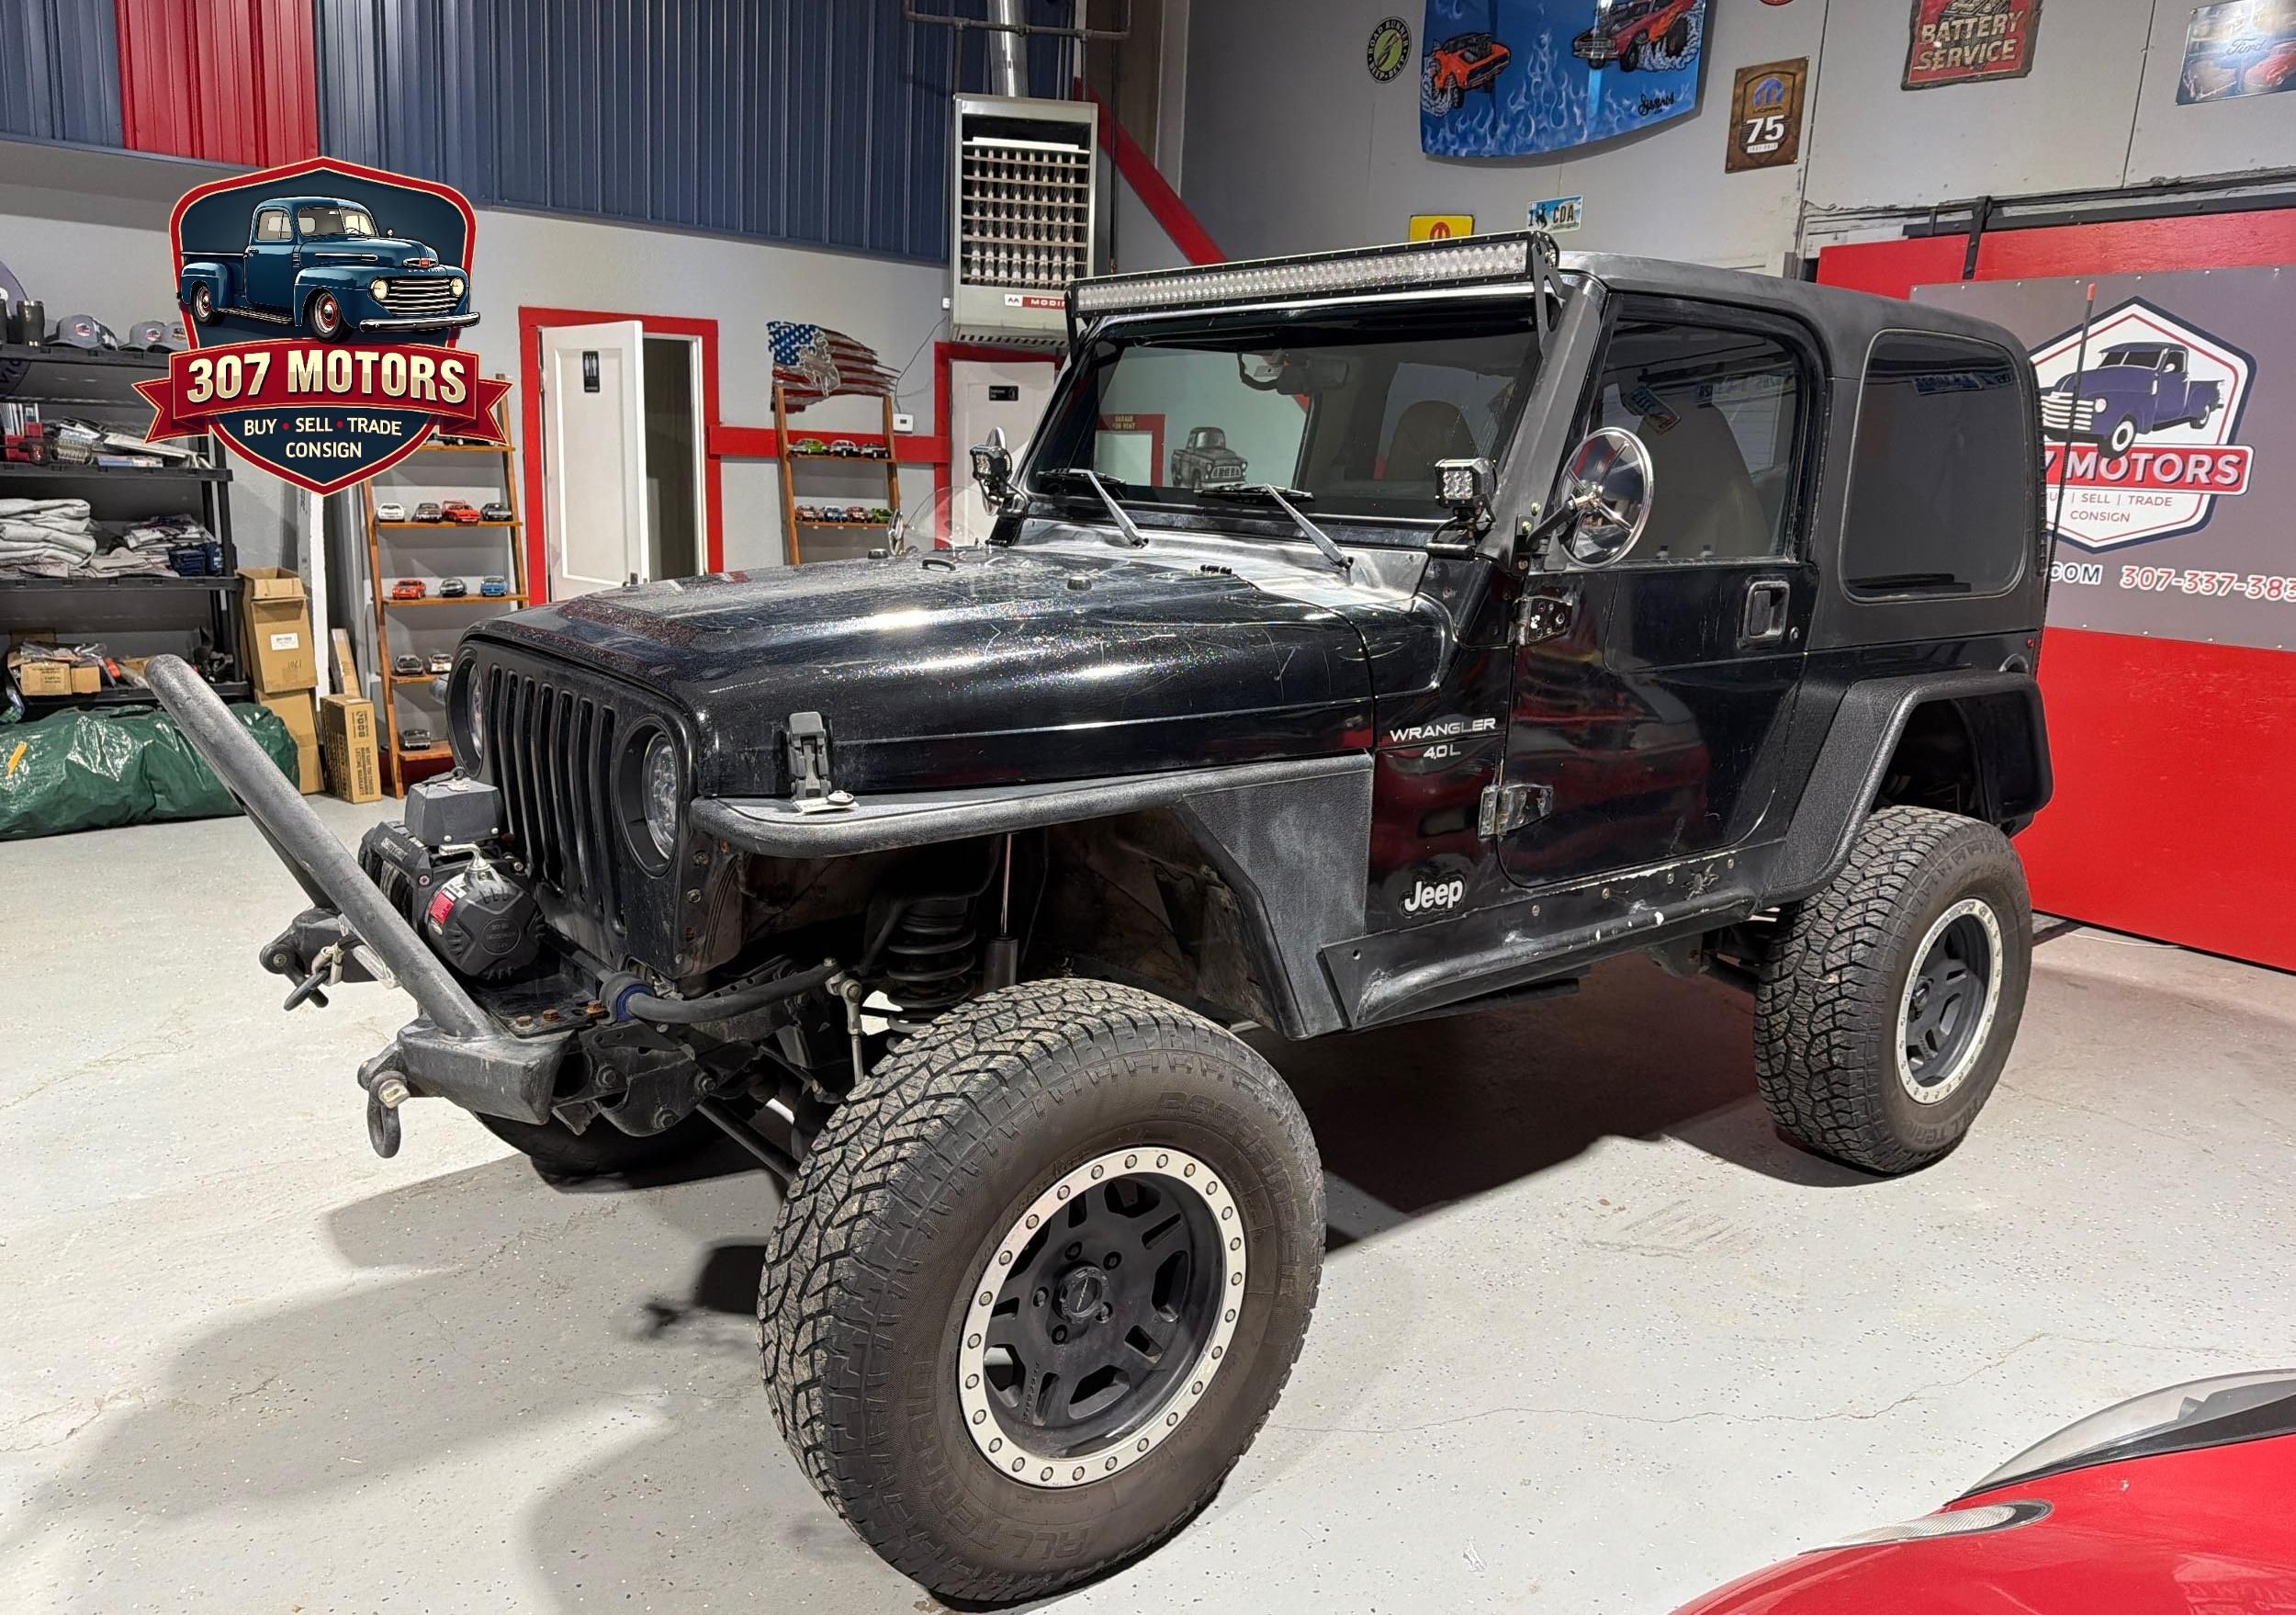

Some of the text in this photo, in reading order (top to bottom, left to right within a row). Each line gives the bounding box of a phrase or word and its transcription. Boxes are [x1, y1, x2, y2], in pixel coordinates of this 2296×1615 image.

[1367, 20, 1409, 54] ROAD RUNNER
[1921, 10, 2023, 44] BATTERY
[1913, 39, 2017, 70] SERVICE
[2226, 38, 2267, 55] Ford
[1746, 114, 1784, 143] 75
[1552, 204, 1574, 224] CDA
[2066, 450, 2242, 486] MOTORS
[2081, 492, 2174, 507] SELL TRADE
[2070, 510, 2131, 523] CONSIGN
[1390, 717, 1496, 742] WRANGLER
[1404, 880, 1463, 911] Jeep
